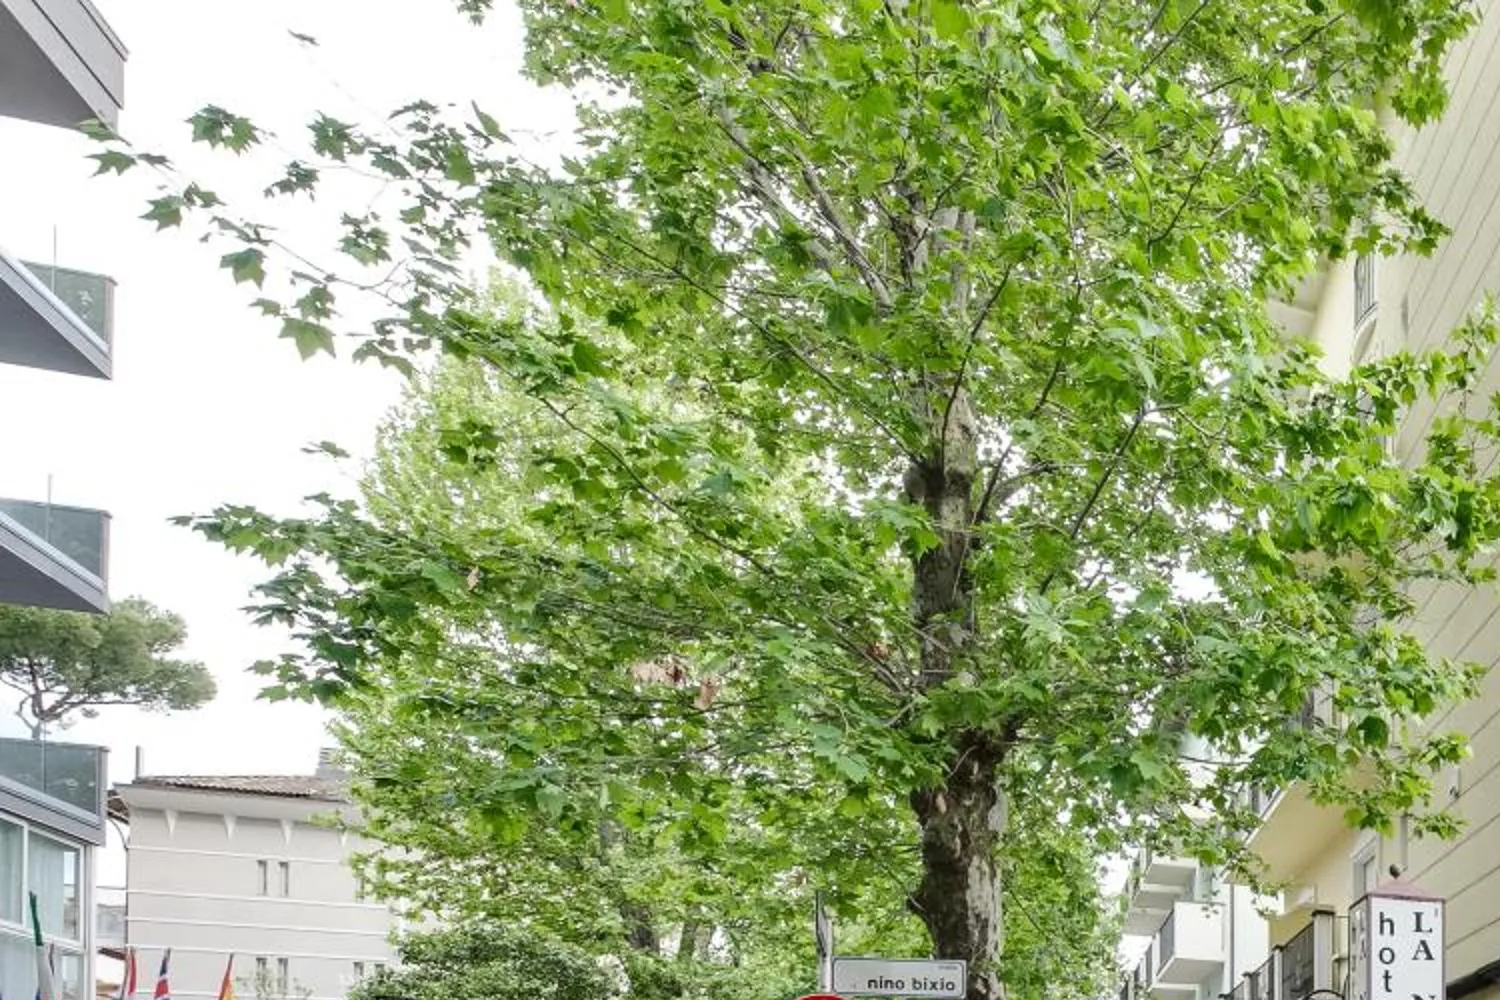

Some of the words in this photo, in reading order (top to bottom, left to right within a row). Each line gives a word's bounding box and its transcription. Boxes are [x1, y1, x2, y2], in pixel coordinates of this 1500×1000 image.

[1411, 911, 1435, 961] LA
[867, 976, 905, 990] nino
[911, 977, 955, 992] bixio
